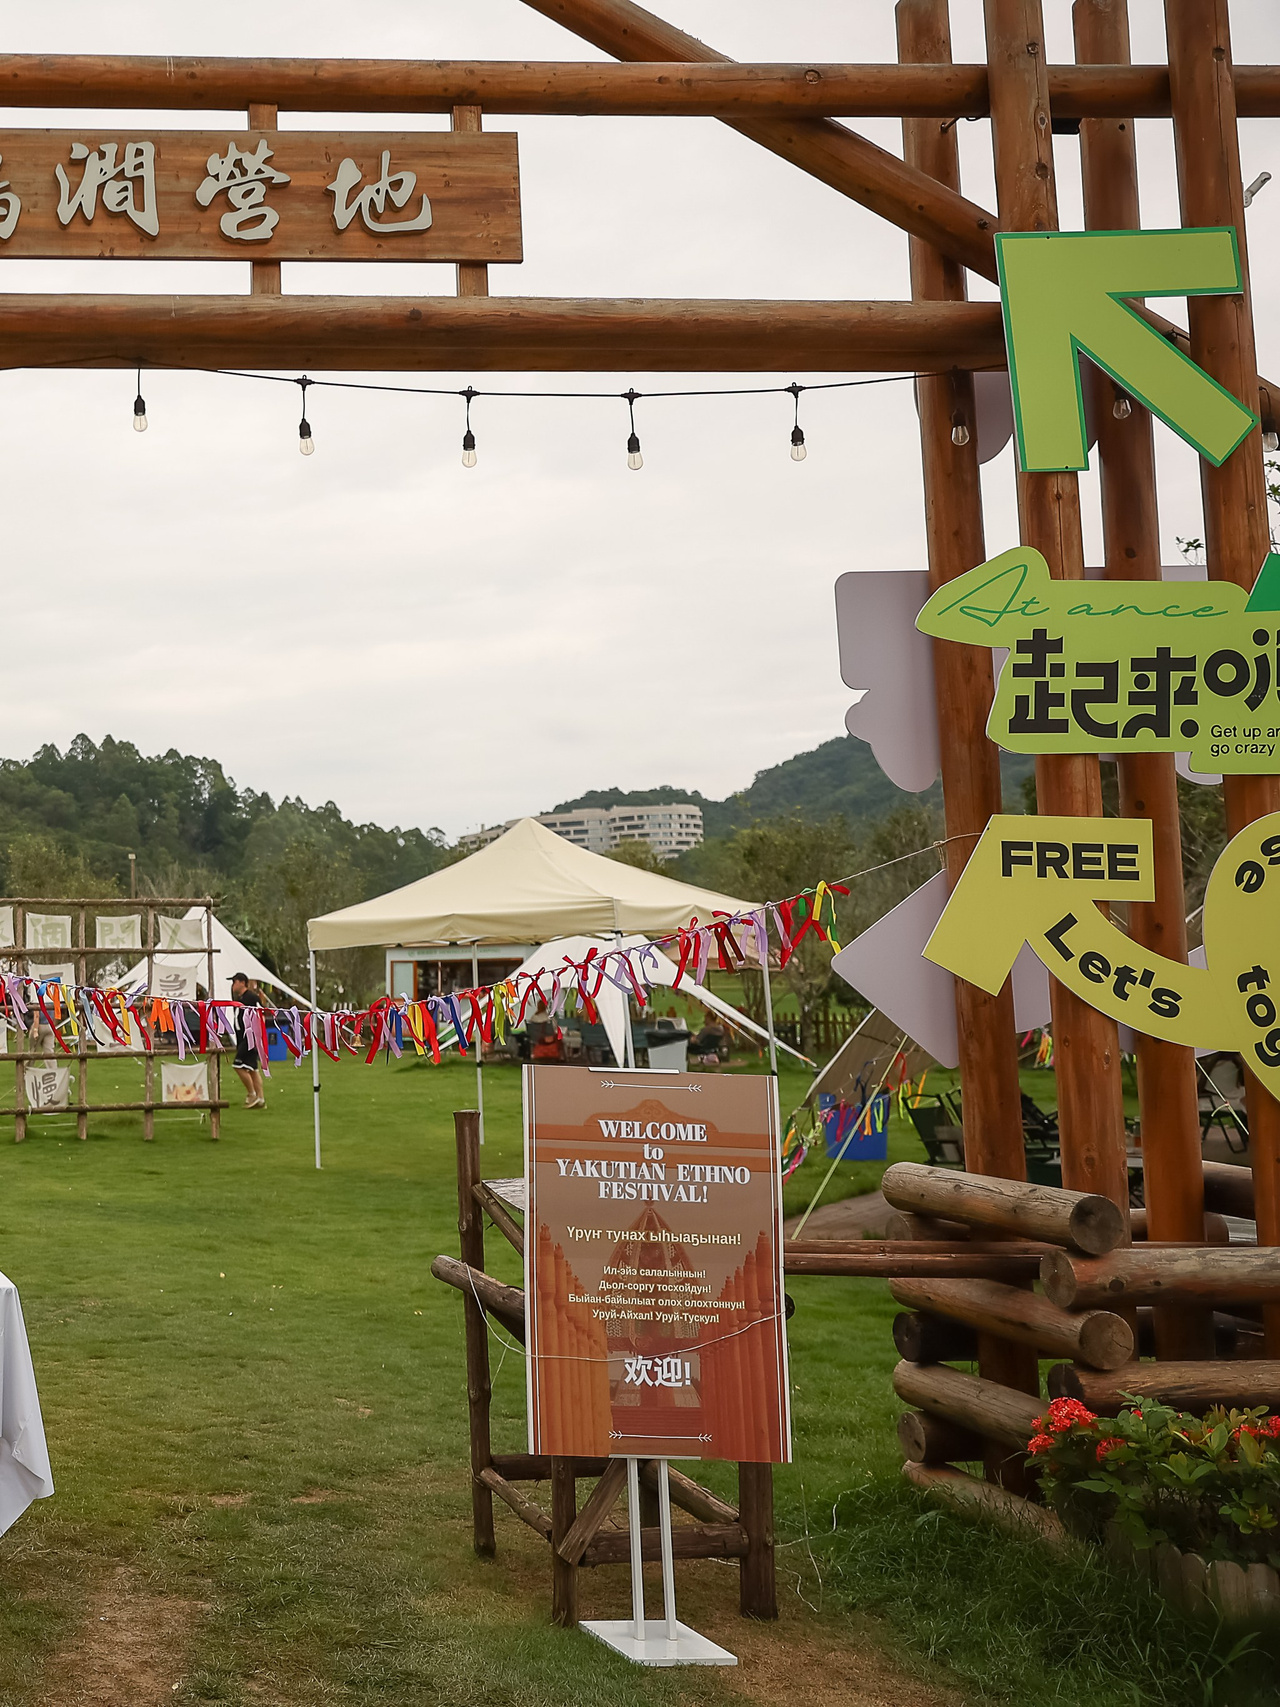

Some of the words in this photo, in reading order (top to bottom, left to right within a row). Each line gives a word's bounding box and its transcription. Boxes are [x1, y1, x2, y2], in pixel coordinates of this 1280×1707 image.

[1210, 724, 1238, 738] Get
[1243, 727, 1262, 741] up
[1210, 743, 1230, 757] go
[1234, 743, 1276, 757] crazy
[1001, 840, 1141, 881] FREE
[1043, 912, 1182, 1020] Let's
[597, 1119, 708, 1143] WELCOME
[642, 1142, 665, 1161] to
[555, 1158, 666, 1181] YAKUTIAN
[676, 1163, 751, 1185] ETHNO
[598, 1180, 709, 1204] FESTIVAL!
[606, 1229, 646, 1243] тунах
[603, 1265, 638, 1276] Ил-эйэ
[598, 1280, 655, 1293] Дьол-соргу
[657, 1283, 712, 1295] тосхойдун!
[657, 1298, 683, 1307] олох
[684, 1299, 746, 1311] олохтоннун!
[592, 1309, 654, 1321] Уруй-Айхал!
[655, 1311, 720, 1325] Уруй-Тускул!
[624, 1355, 692, 1388] 欢迎!
